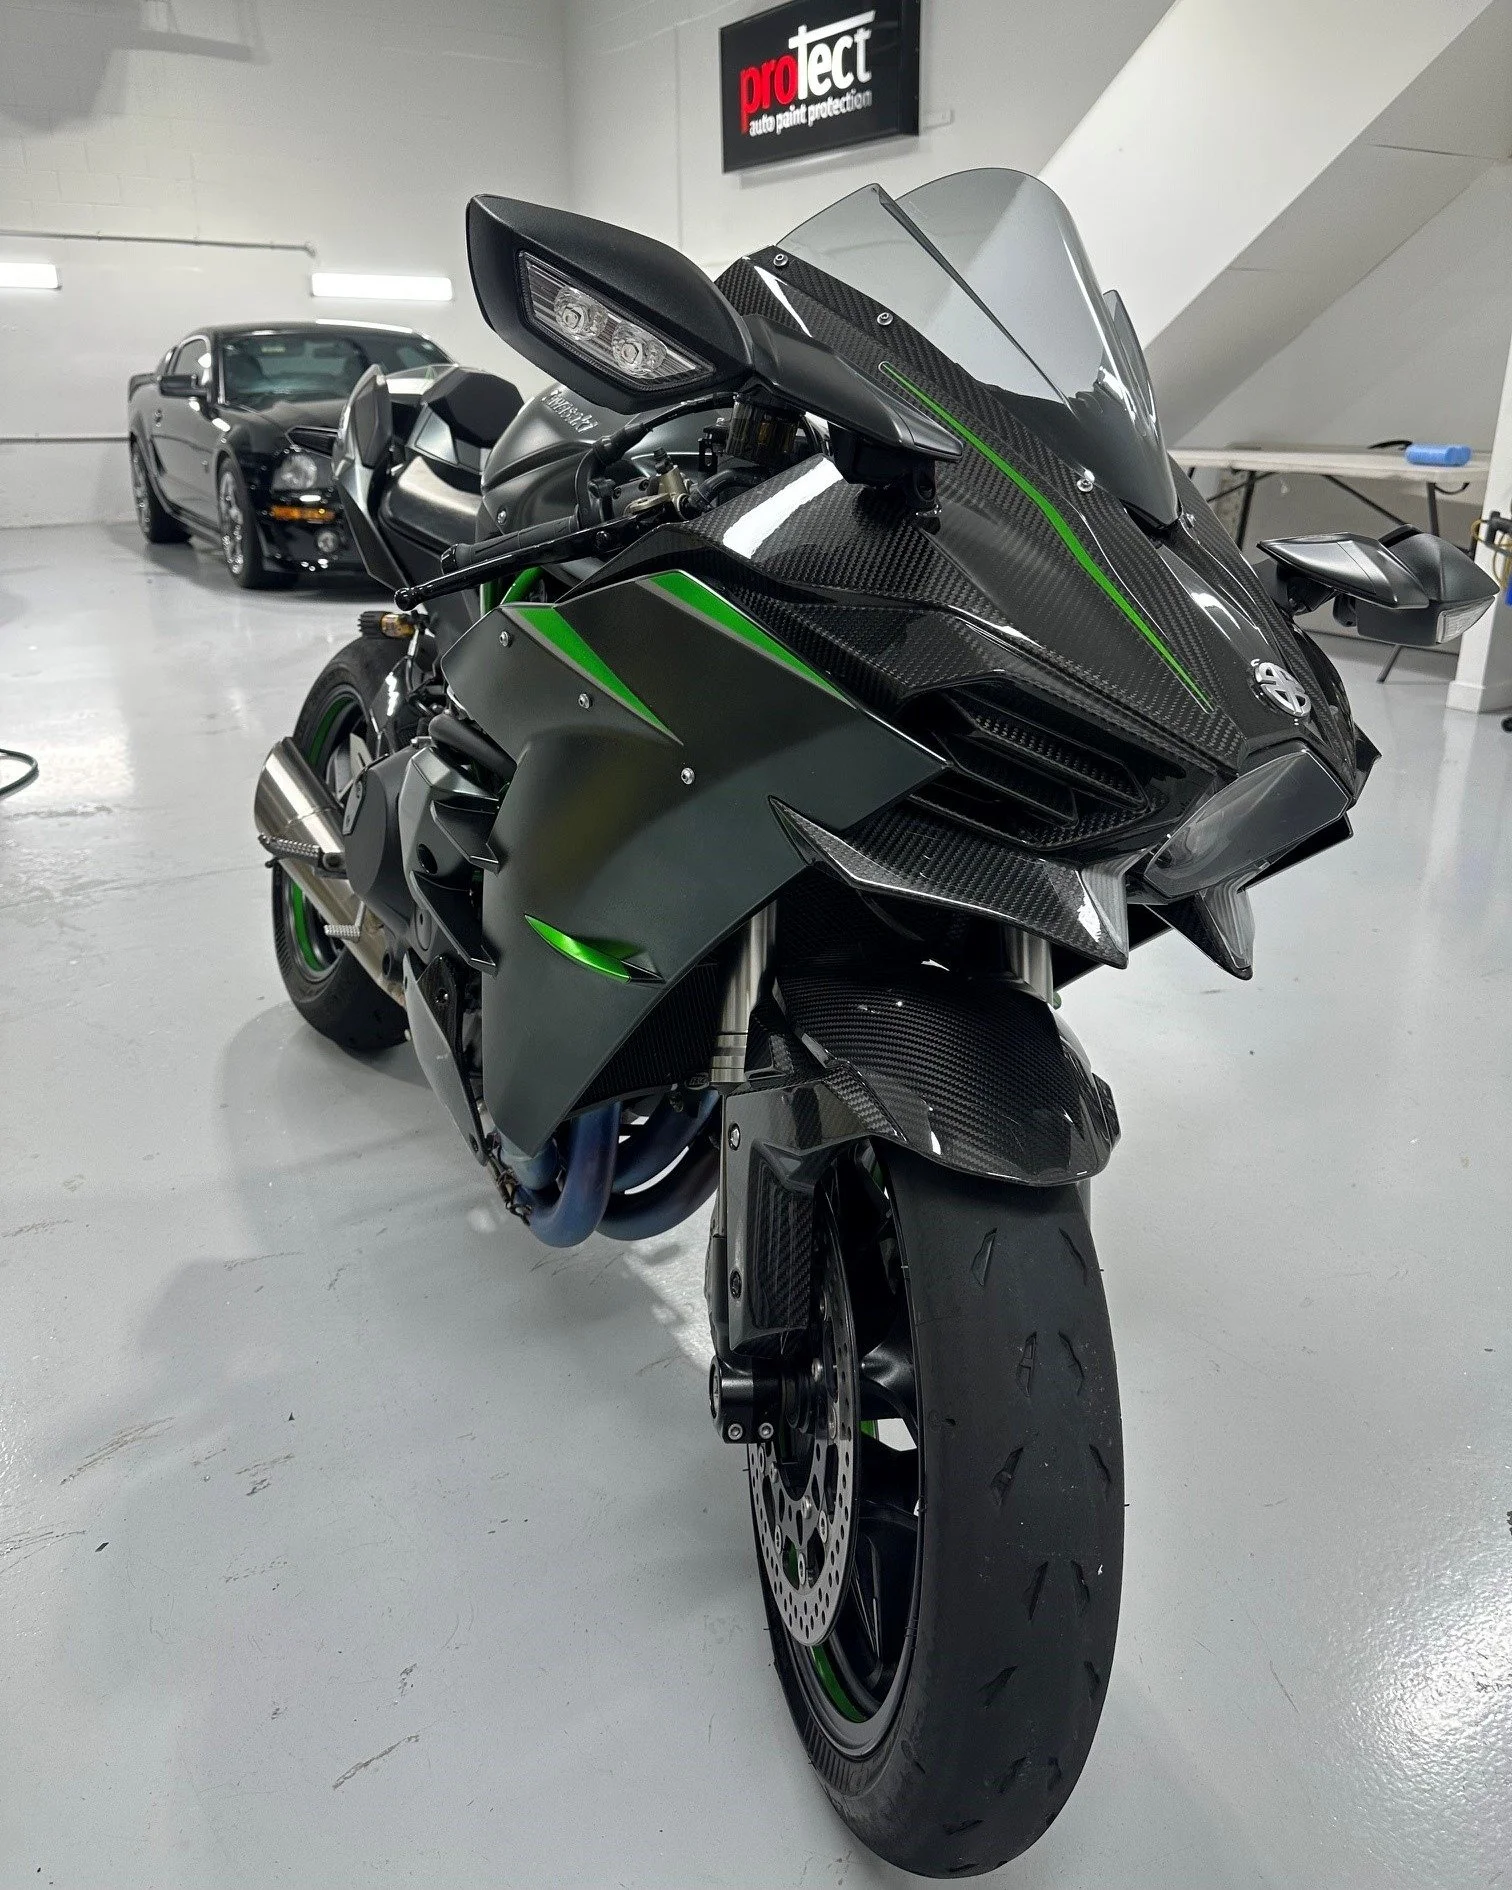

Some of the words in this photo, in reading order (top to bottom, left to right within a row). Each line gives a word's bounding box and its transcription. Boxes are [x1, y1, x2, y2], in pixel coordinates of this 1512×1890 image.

[749, 114, 776, 137] auto
[776, 104, 807, 135] paint
[808, 89, 873, 127] protection
